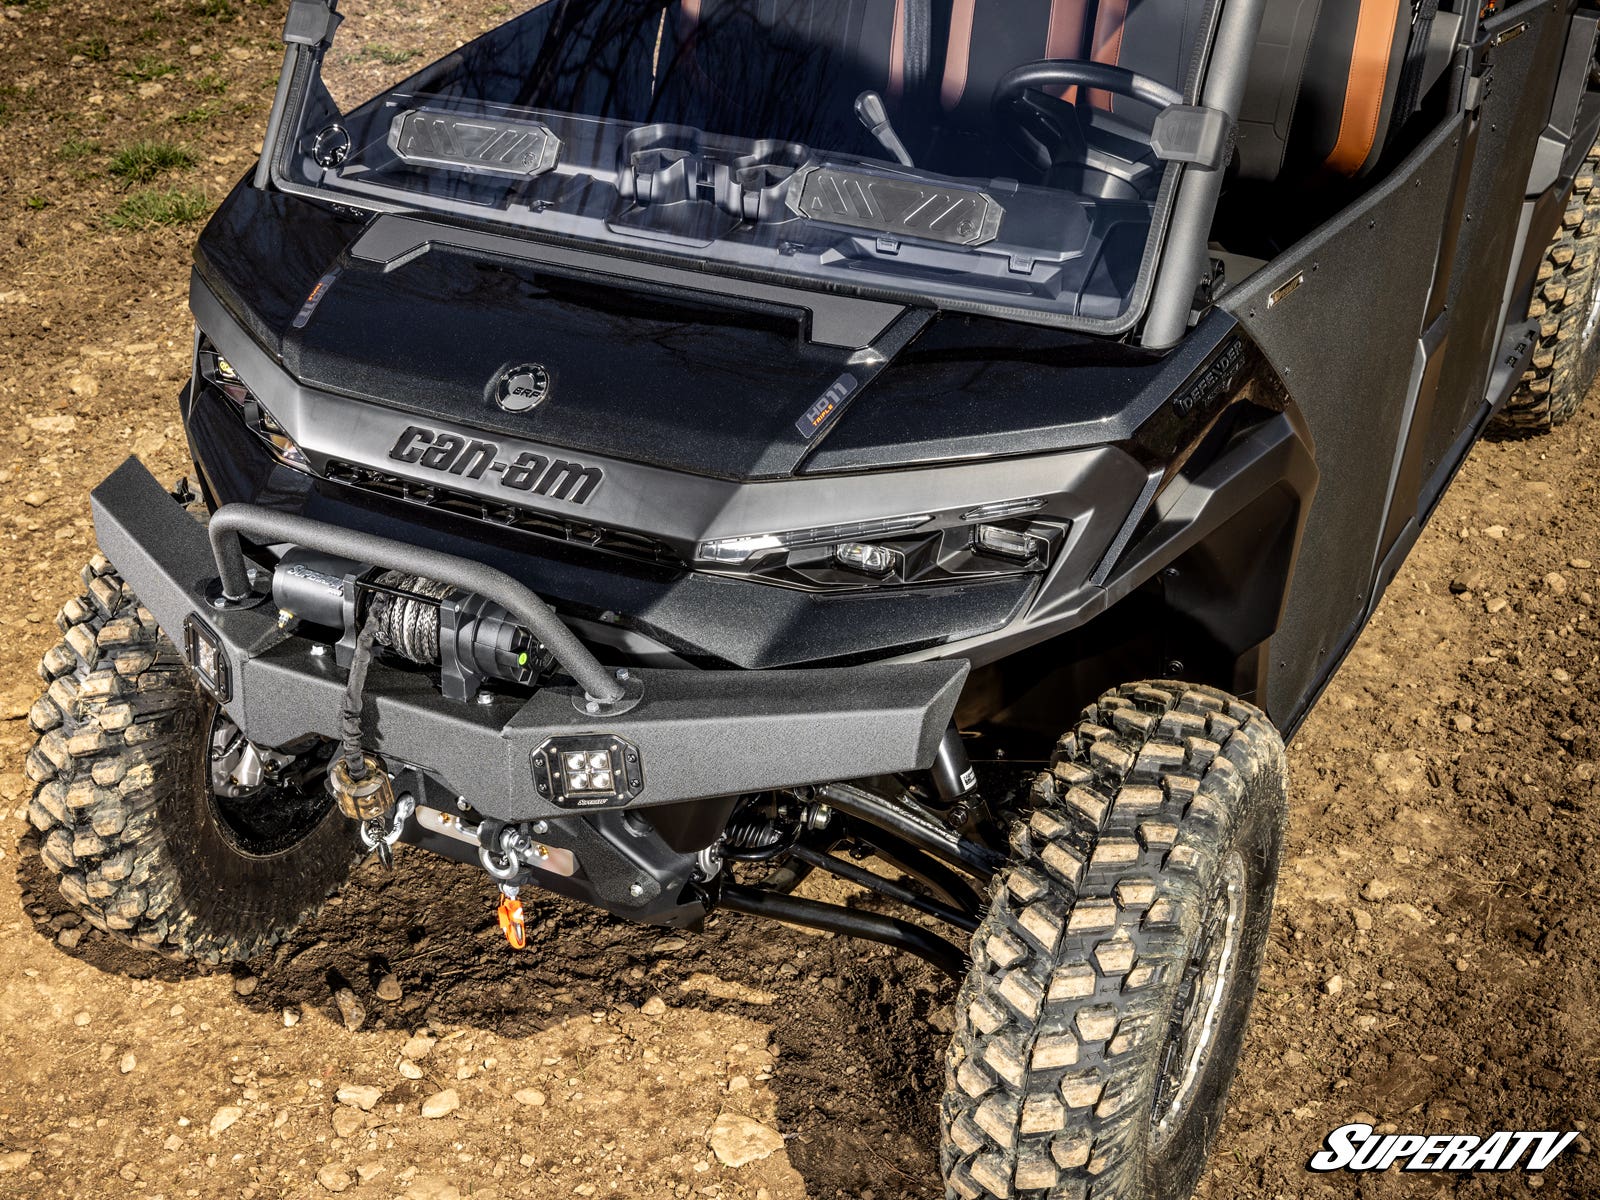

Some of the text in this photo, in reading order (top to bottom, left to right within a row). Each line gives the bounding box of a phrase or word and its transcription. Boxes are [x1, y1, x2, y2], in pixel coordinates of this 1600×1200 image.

[512, 386, 541, 398] BRP
[806, 382, 848, 423] HD11
[812, 403, 833, 427] TRIPLE
[388, 425, 604, 504] can-am
